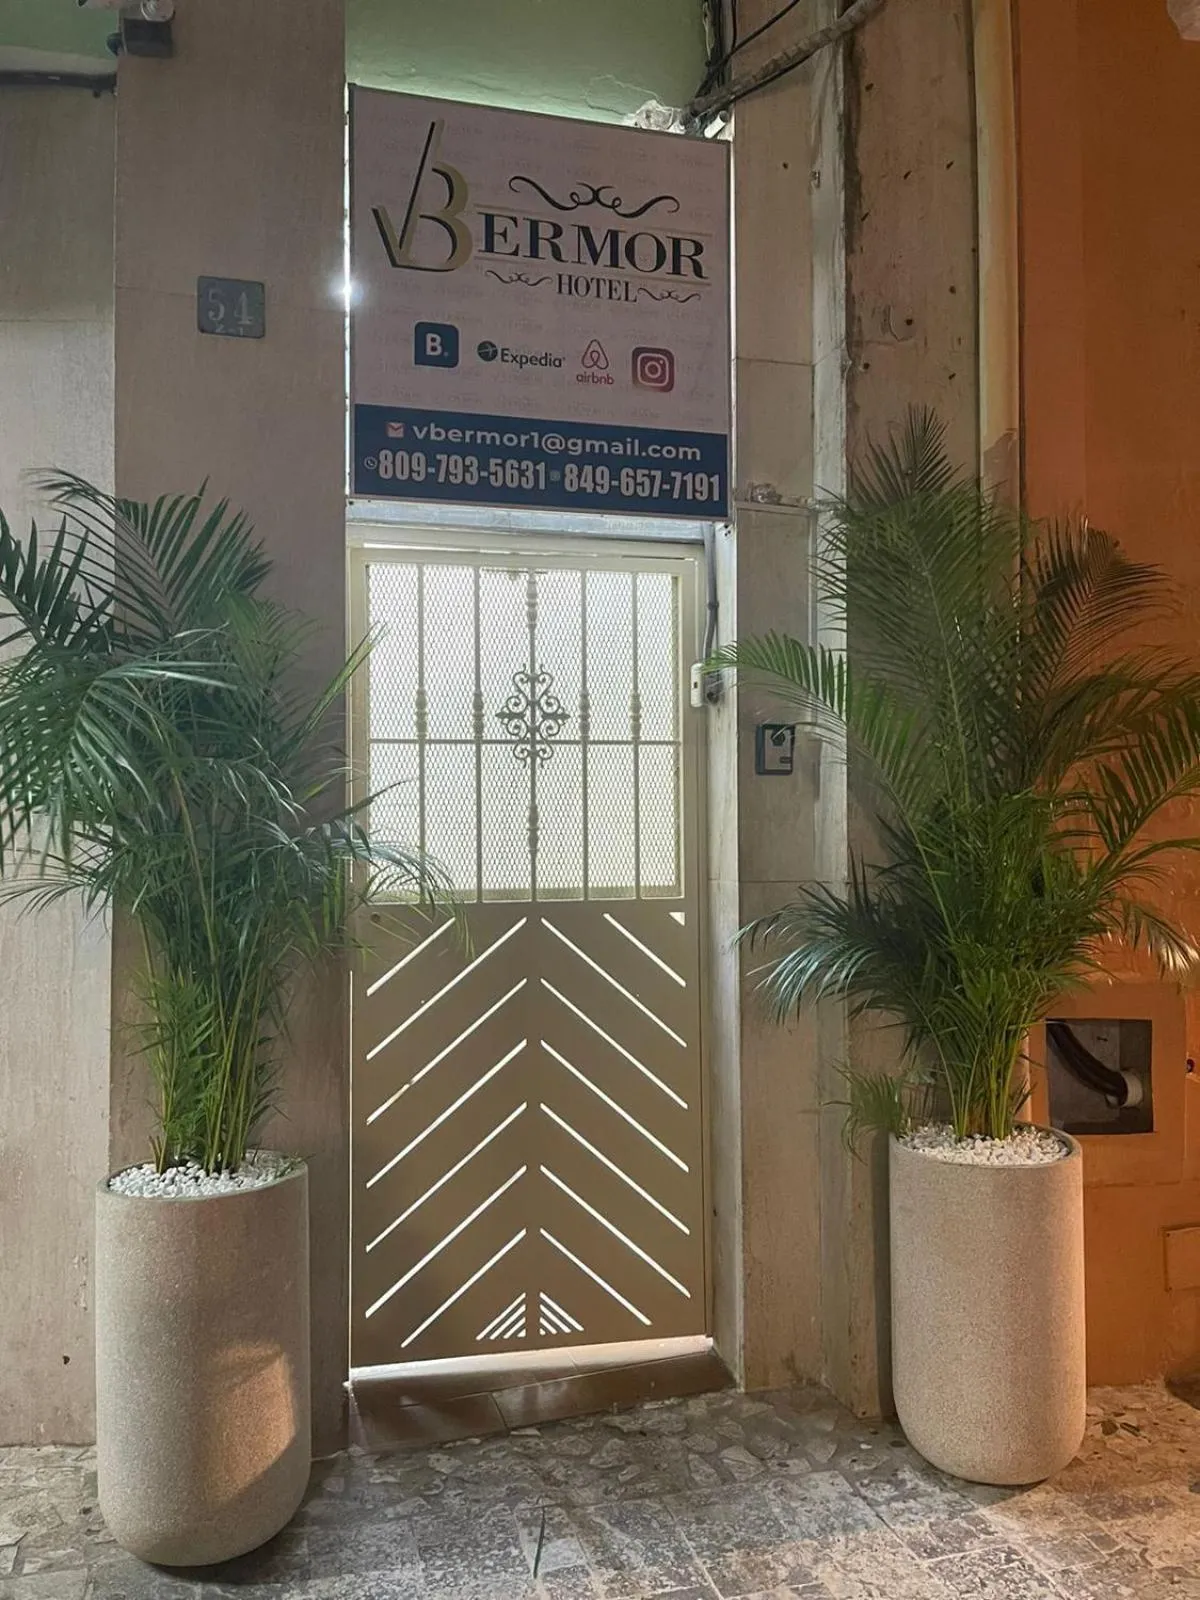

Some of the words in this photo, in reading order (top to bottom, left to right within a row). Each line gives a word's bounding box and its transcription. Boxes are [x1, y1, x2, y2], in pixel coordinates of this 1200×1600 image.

[556, 273, 638, 303] HOTEL
[500, 348, 563, 370] Expedia
[575, 371, 616, 386] airbnb
[412, 422, 702, 462] vbermor1@gmail.com
[378, 449, 547, 491] 809-793-5631
[564, 463, 721, 502] 849-657-7191
